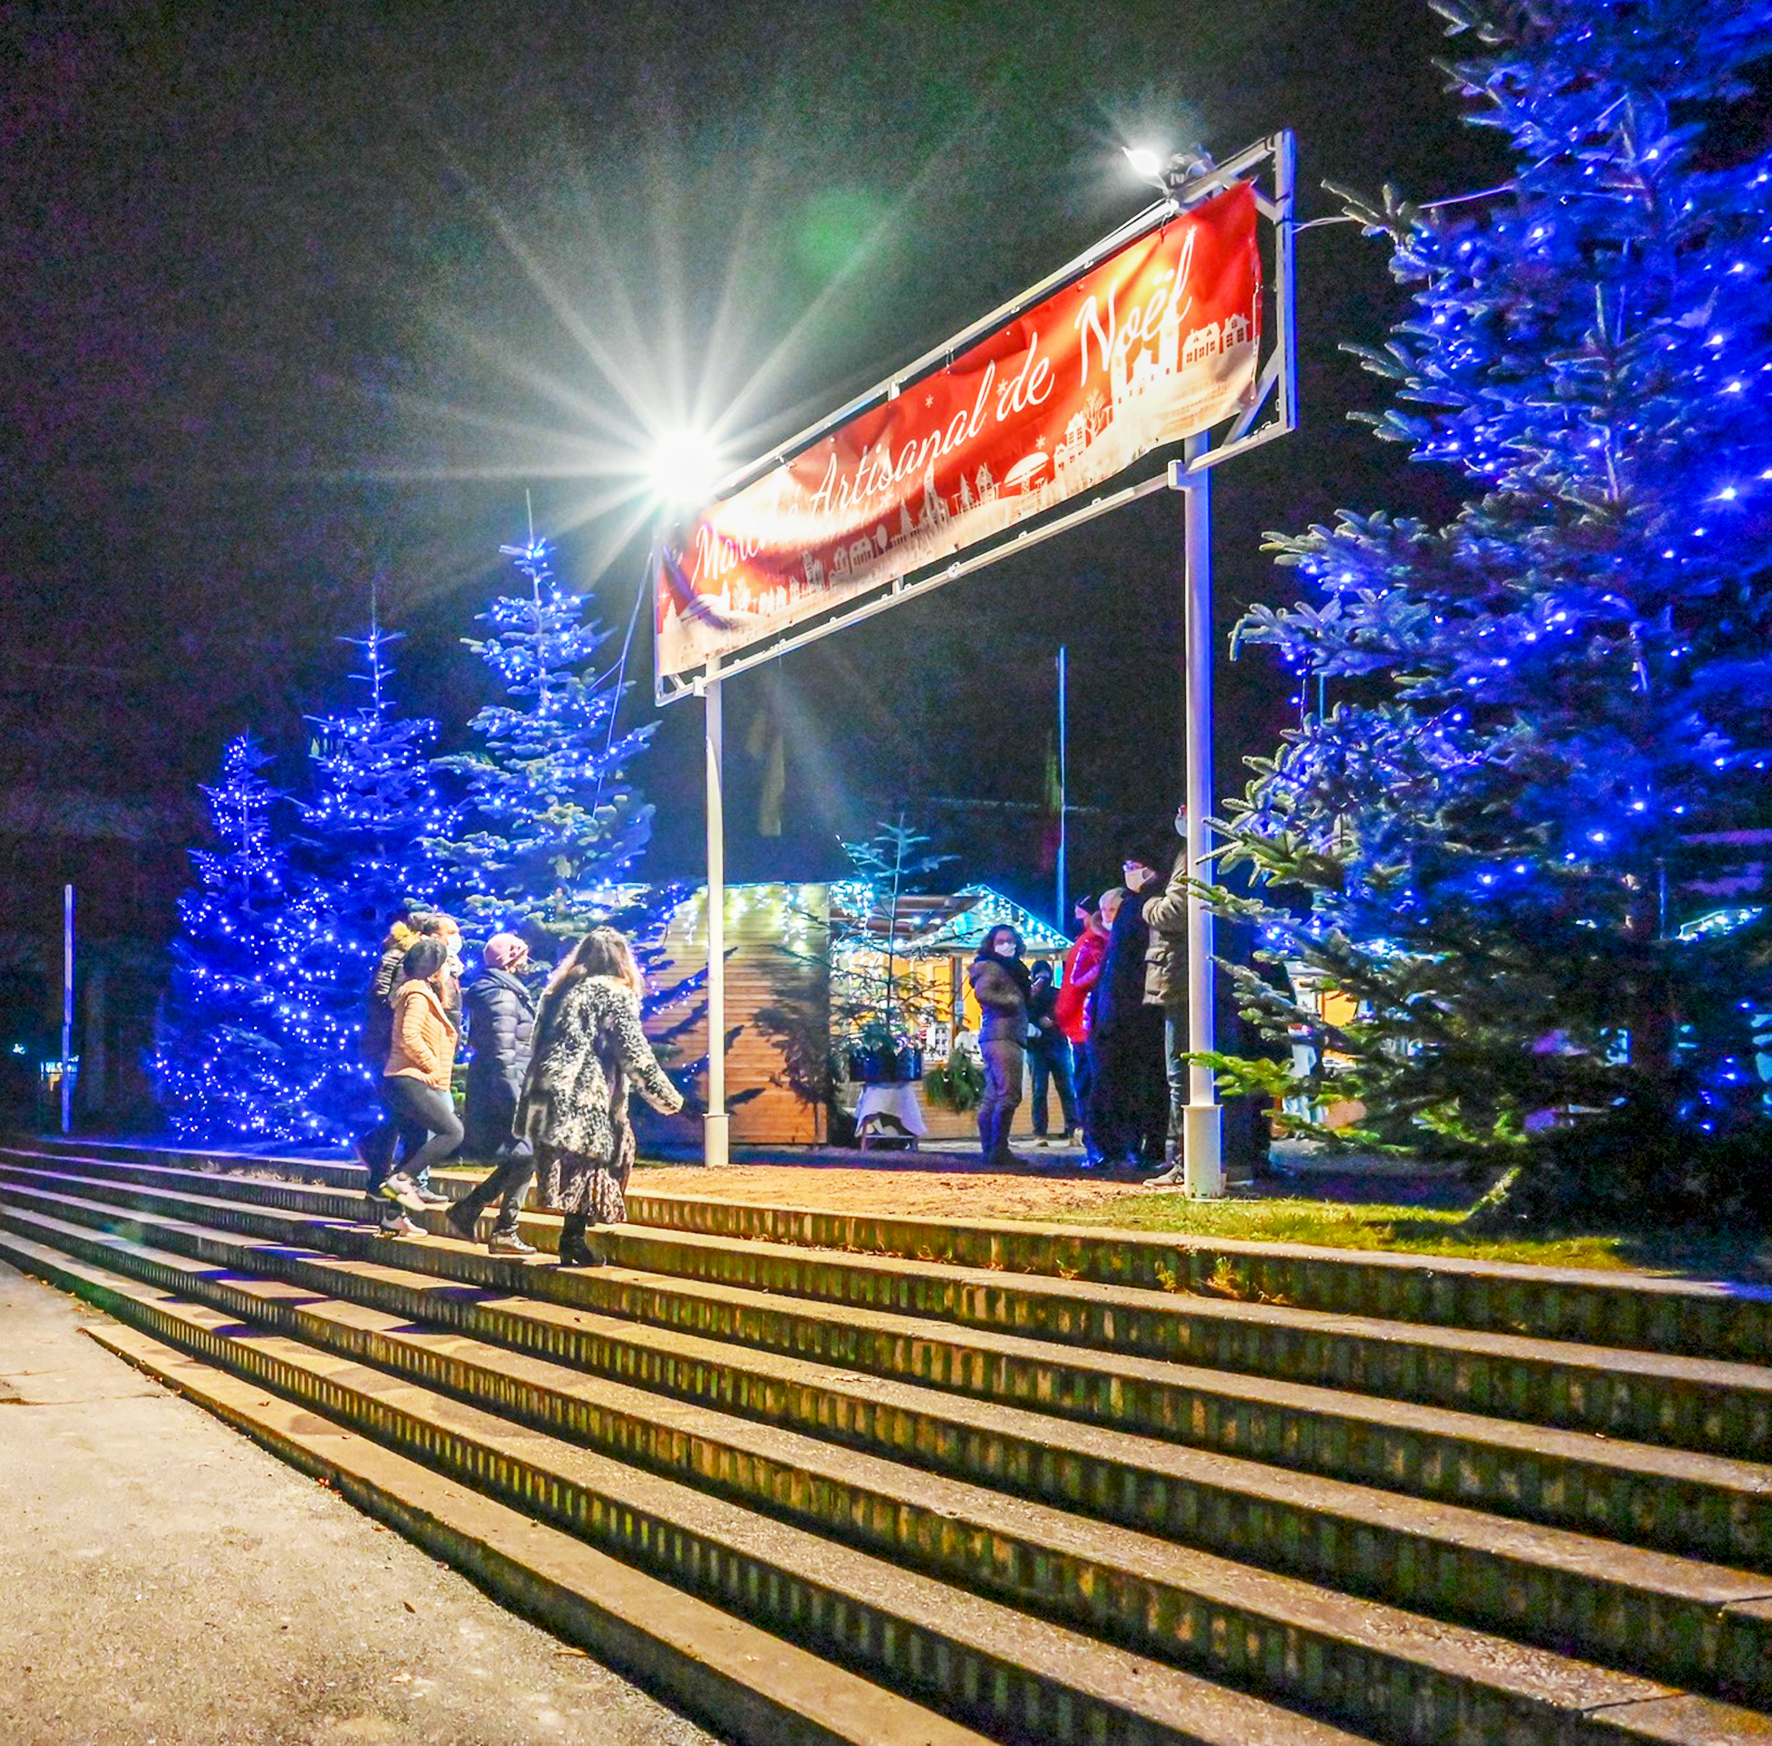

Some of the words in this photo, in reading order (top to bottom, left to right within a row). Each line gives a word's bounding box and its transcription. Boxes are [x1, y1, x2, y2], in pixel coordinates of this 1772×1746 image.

[810, 359, 996, 519] Artisanal
[996, 331, 1055, 422] de
[1074, 227, 1196, 388] Noël
